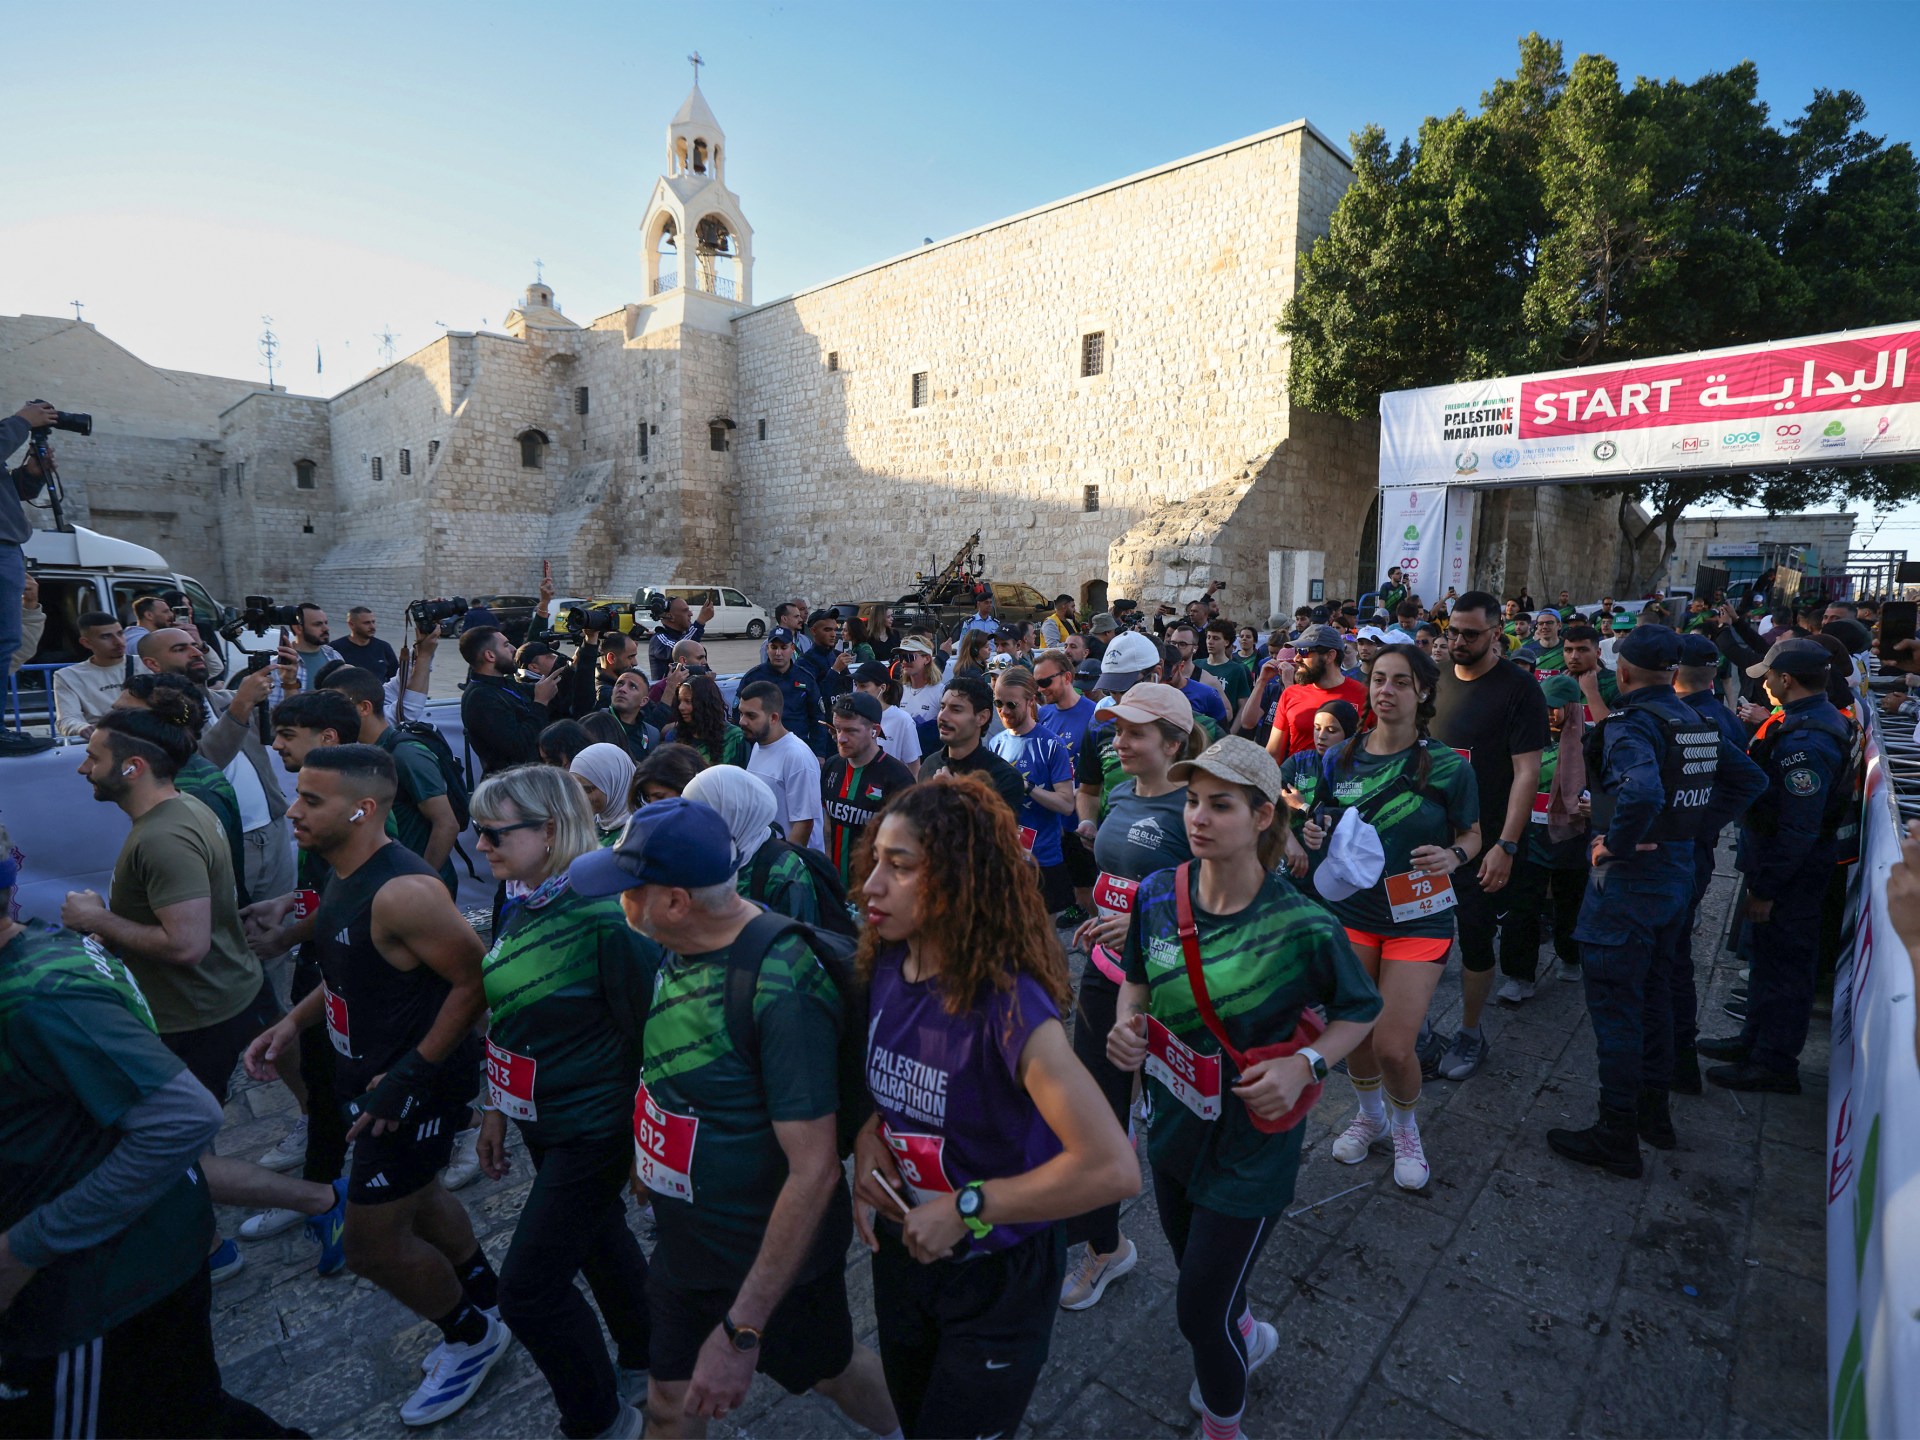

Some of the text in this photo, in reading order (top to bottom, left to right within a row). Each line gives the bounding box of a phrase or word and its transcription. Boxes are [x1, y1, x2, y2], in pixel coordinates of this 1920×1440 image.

[1533, 378, 1682, 425] START
[1444, 406, 1514, 427] PALESTINE
[1443, 423, 1513, 441] MARATHON
[1781, 751, 1807, 768] POLICE
[1128, 827, 1163, 844] BIG BLUE
[1105, 889, 1129, 909] 426
[1411, 880, 1433, 897] 78
[1419, 899, 1433, 910] 42
[487, 1057, 511, 1087] 613
[872, 1046, 949, 1095] PALESTINE
[1165, 1046, 1196, 1082] 653
[491, 1086, 502, 1102] 21
[869, 1068, 947, 1117] MARATHON
[1172, 1076, 1185, 1096] 21
[893, 1101, 905, 1113] OF
[905, 1105, 945, 1129] MOVEMENT
[640, 1118, 666, 1157] 612
[642, 1157, 654, 1178] 21
